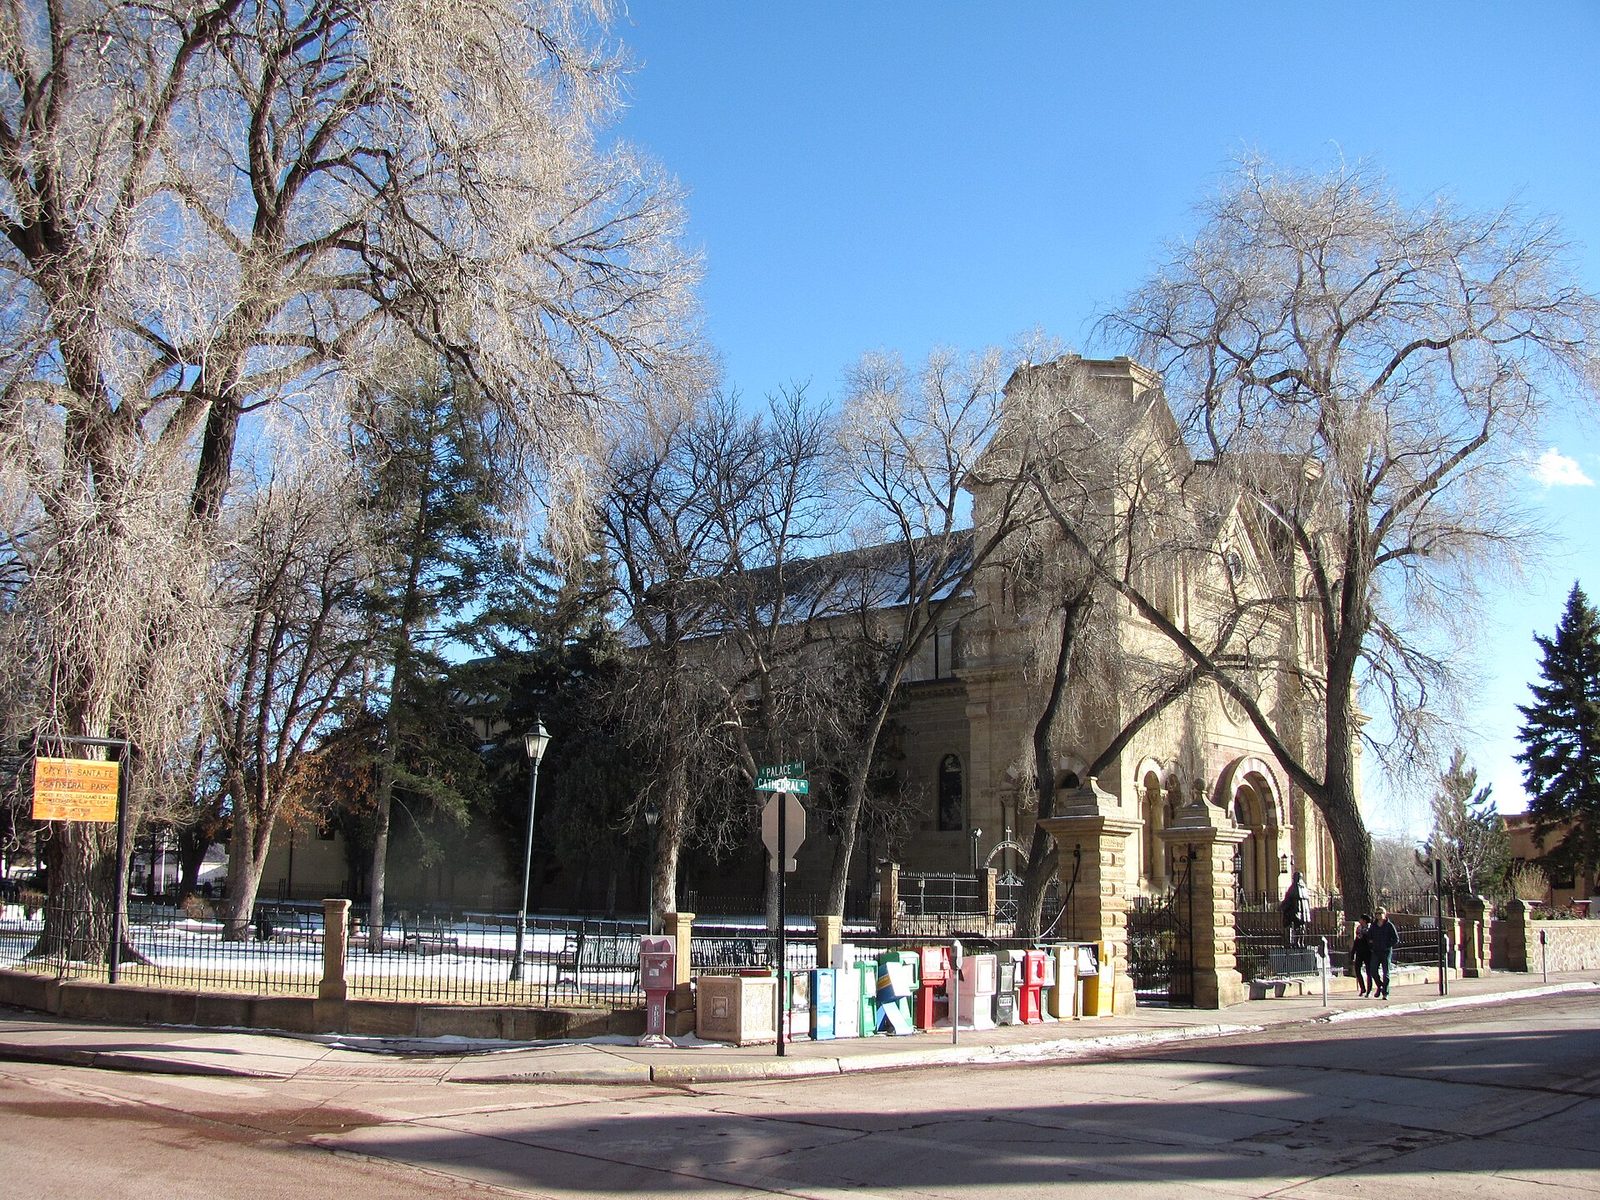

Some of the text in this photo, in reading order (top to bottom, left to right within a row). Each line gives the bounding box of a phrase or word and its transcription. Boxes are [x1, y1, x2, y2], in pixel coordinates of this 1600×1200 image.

[77, 768, 101, 777] SANTA
[104, 770, 113, 778] FE
[766, 764, 792, 778] PALACE
[91, 782, 111, 791] PARK
[757, 777, 801, 792] CATHEDRAL
